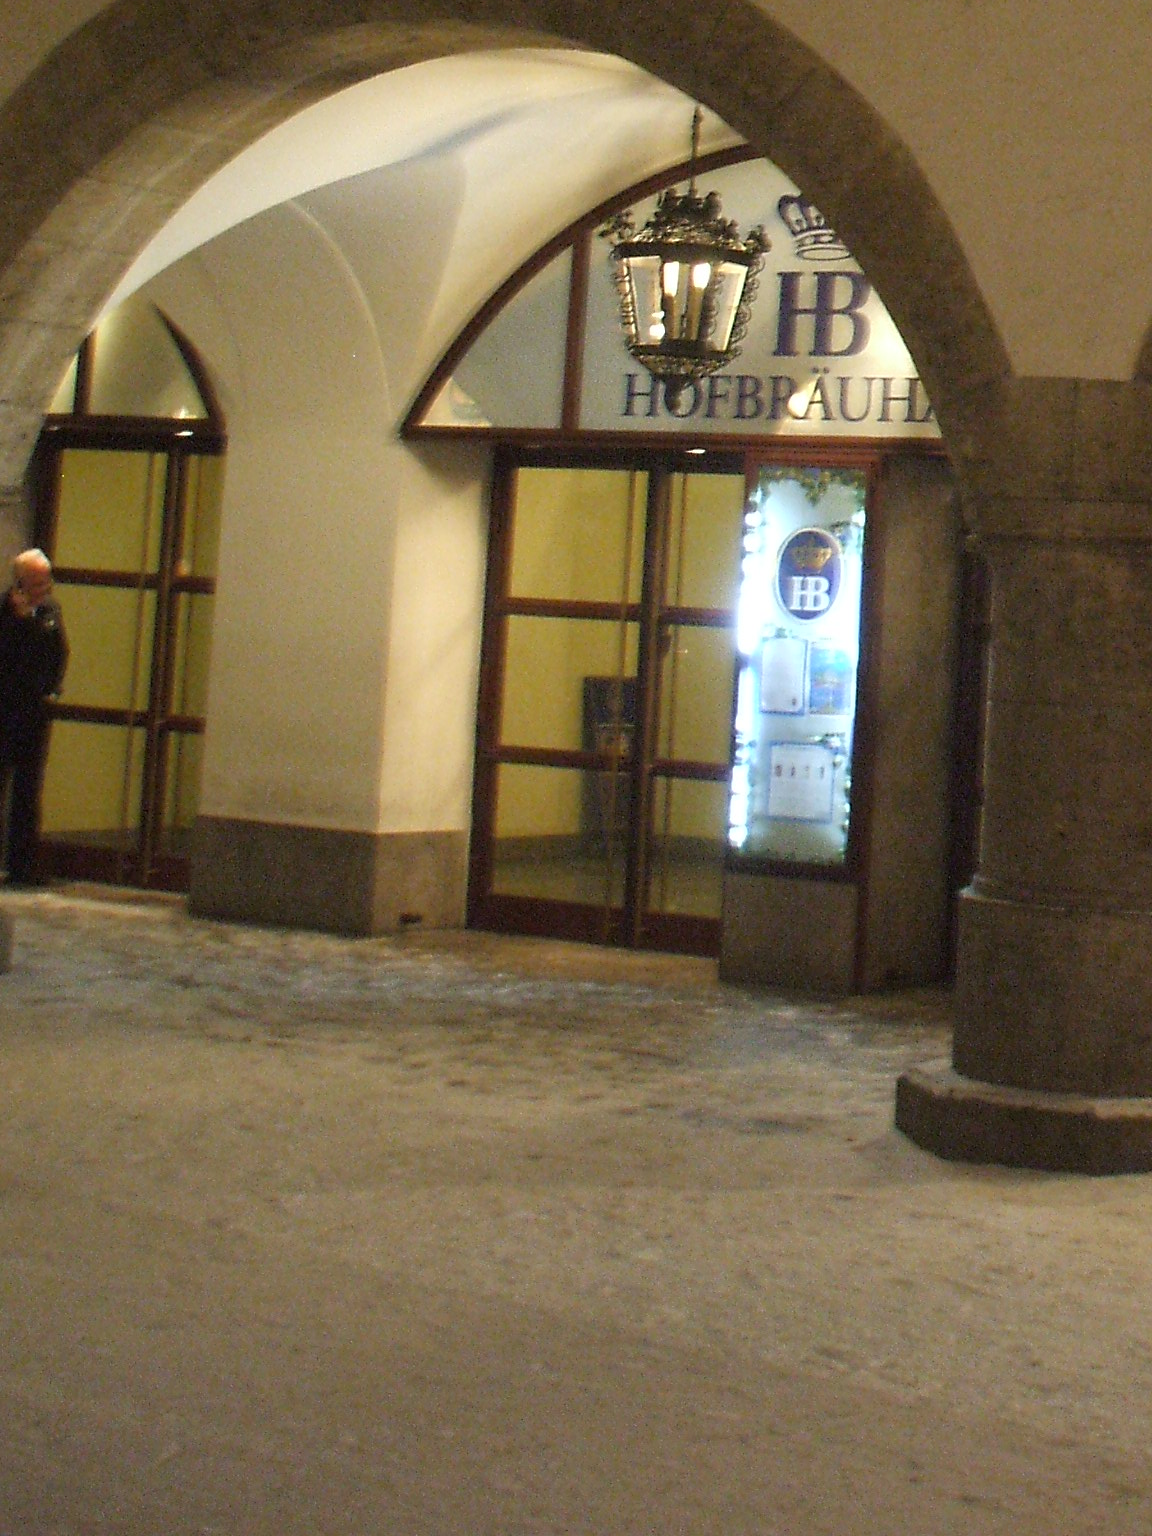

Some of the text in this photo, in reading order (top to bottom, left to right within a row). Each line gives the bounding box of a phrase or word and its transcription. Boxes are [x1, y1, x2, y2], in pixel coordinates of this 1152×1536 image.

[772, 270, 871, 358] HB
[623, 368, 937, 422] HOFBRÄUH
[788, 576, 831, 611] HB
